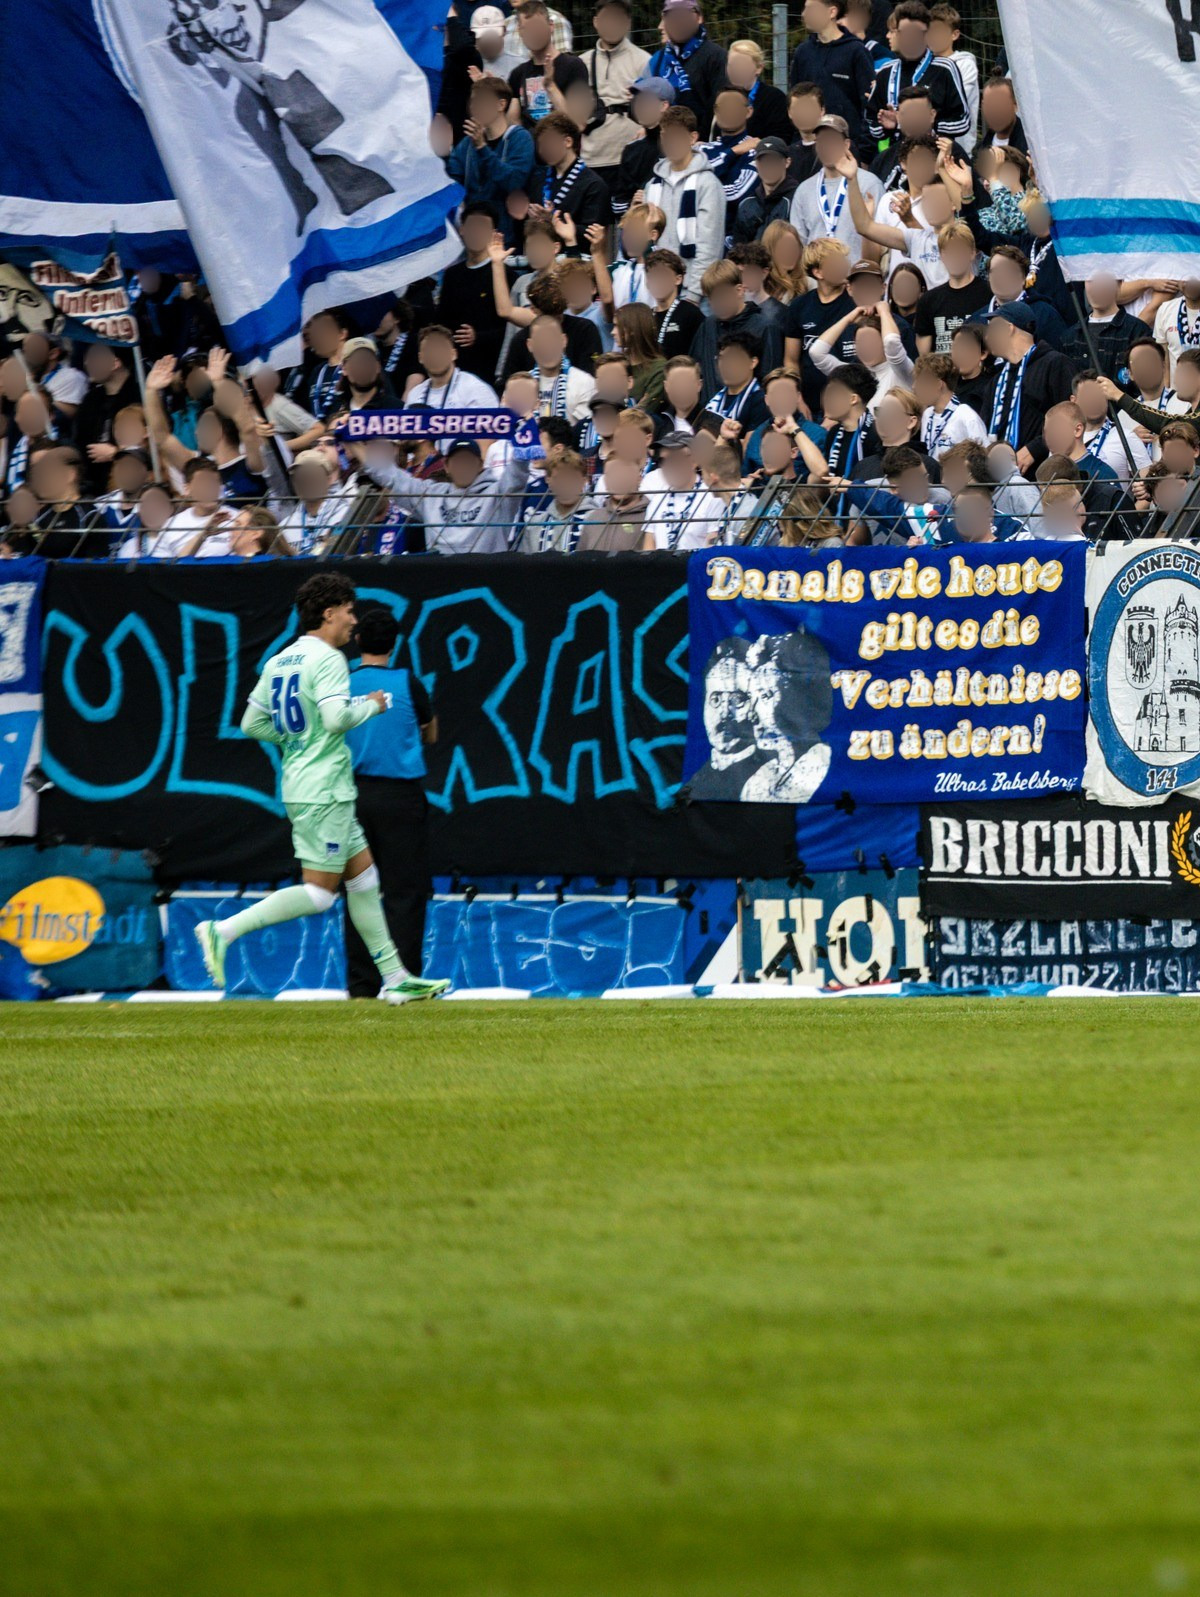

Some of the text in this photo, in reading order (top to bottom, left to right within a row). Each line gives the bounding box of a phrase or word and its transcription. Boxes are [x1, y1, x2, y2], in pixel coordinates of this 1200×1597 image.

[349, 414, 512, 436] BABELSBERG
[706, 556, 1063, 603] Damals wie heute
[859, 608, 1039, 660] gilt es die
[42, 583, 690, 814] ULRAS
[269, 671, 308, 736] 36
[830, 664, 1081, 710] Verhältnisse
[847, 714, 1046, 761] zu ändern!
[934, 770, 1079, 794] Ultras Babelsberg
[1146, 767, 1178, 792] 144
[926, 815, 1172, 878] BRICCONI
